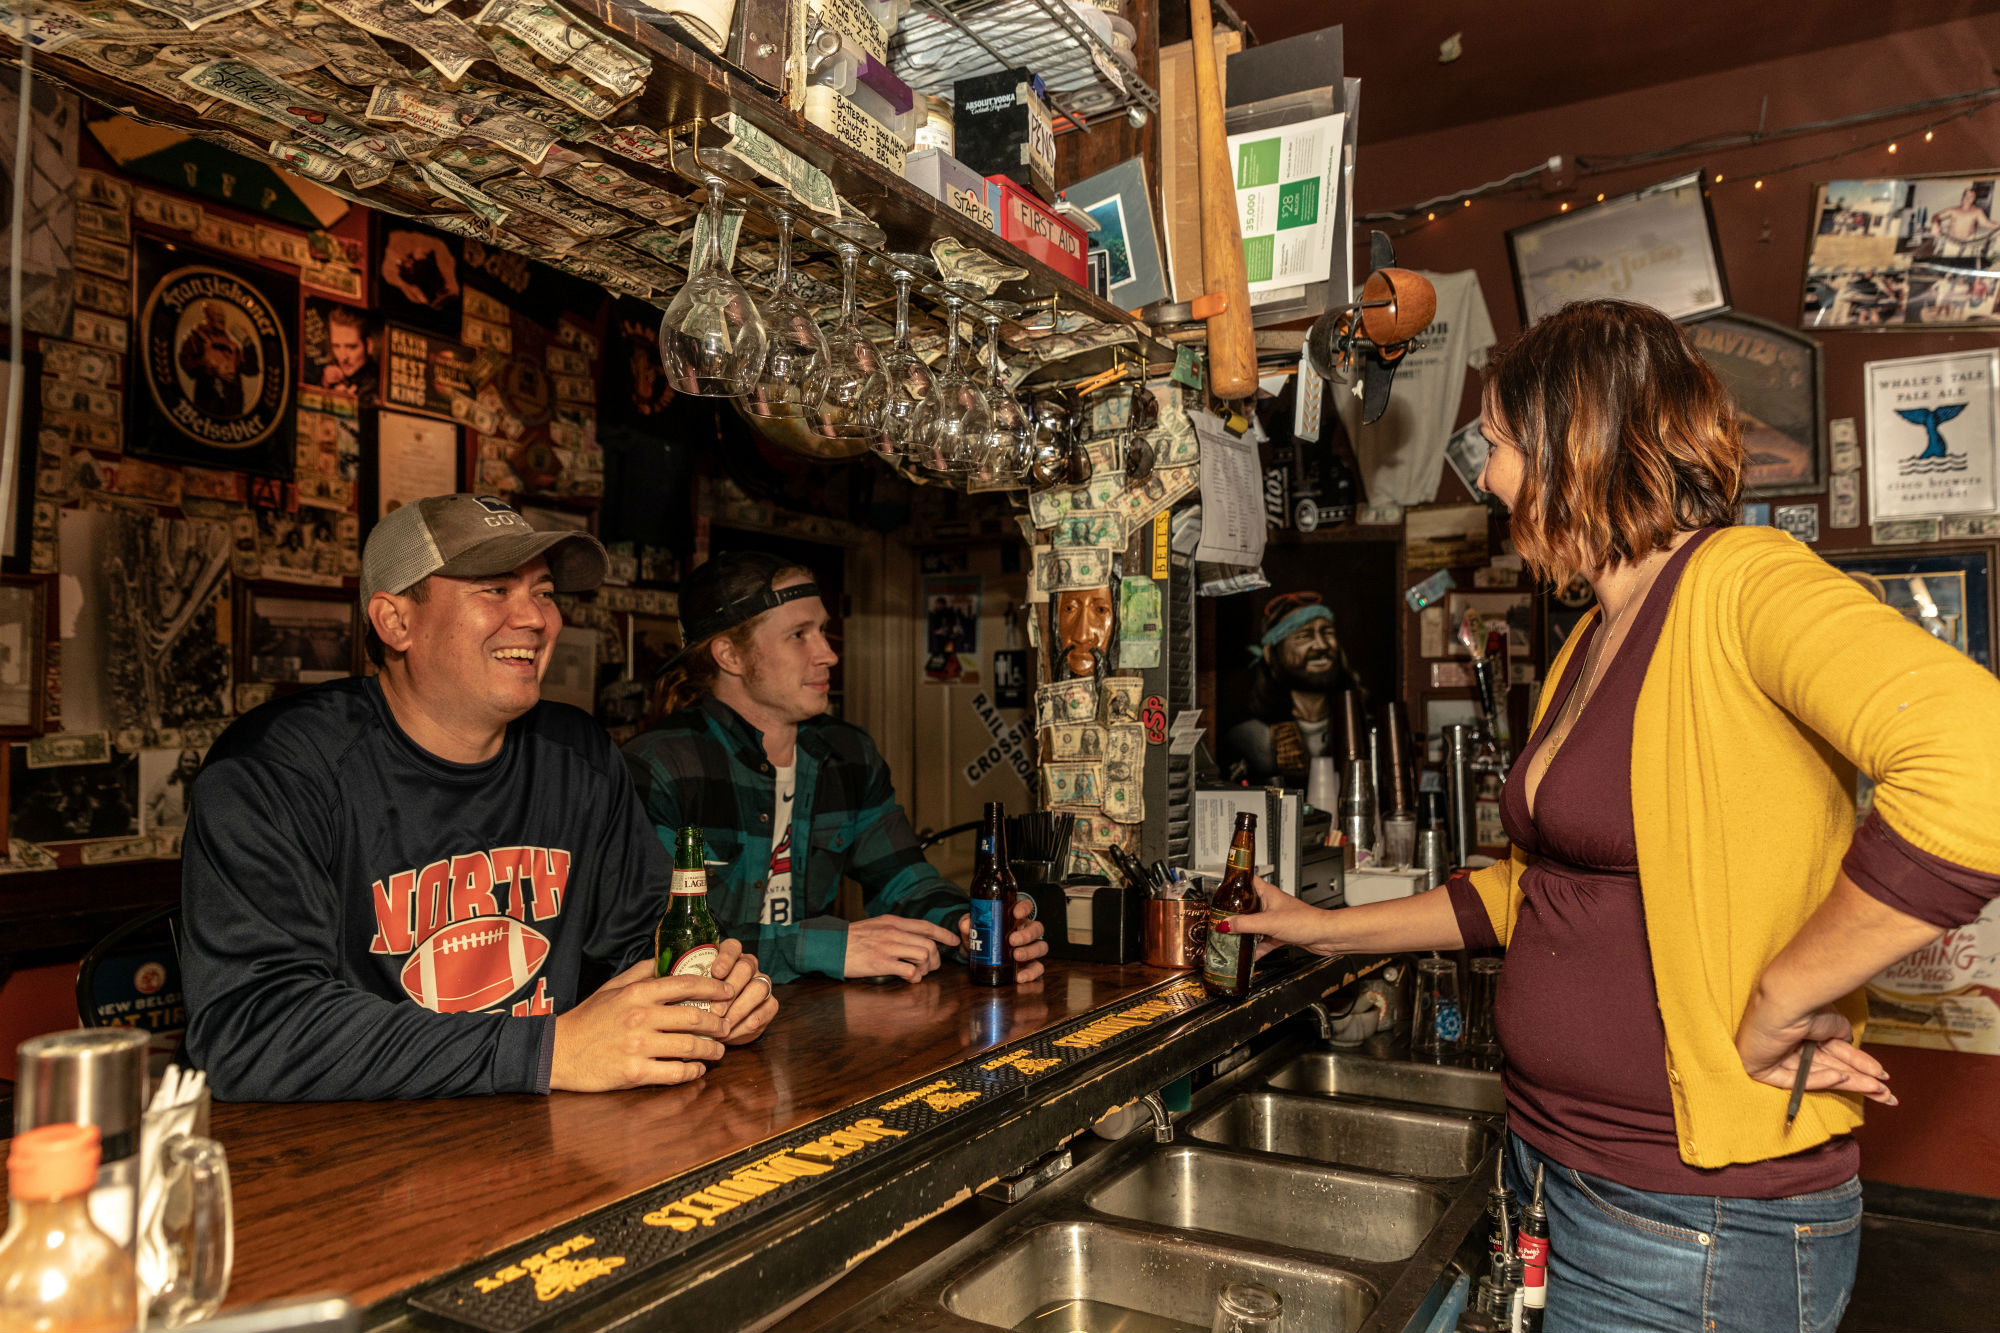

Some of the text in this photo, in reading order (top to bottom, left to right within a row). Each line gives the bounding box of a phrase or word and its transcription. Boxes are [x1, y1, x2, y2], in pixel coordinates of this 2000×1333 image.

[993, 93, 1016, 105] VODKA
[1030, 113, 1055, 169] PENS
[953, 190, 995, 232] STAPLES
[1246, 193, 1256, 231] 35,000
[1281, 194, 1294, 219] $28
[1021, 203, 1077, 255] FIRST AID
[391, 354, 427, 378] BEST
[391, 370, 427, 391] DRAG
[1878, 370, 1985, 390] WHALE'S TALE
[391, 384, 427, 407] KING
[1896, 388, 1966, 403] PALE ALE
[1156, 513, 1168, 573] BELL'S
[972, 693, 1004, 739] RAIL
[684, 879, 708, 889] LAGE
[369, 845, 573, 956] NORTH
[1904, 944, 1979, 971] THING
